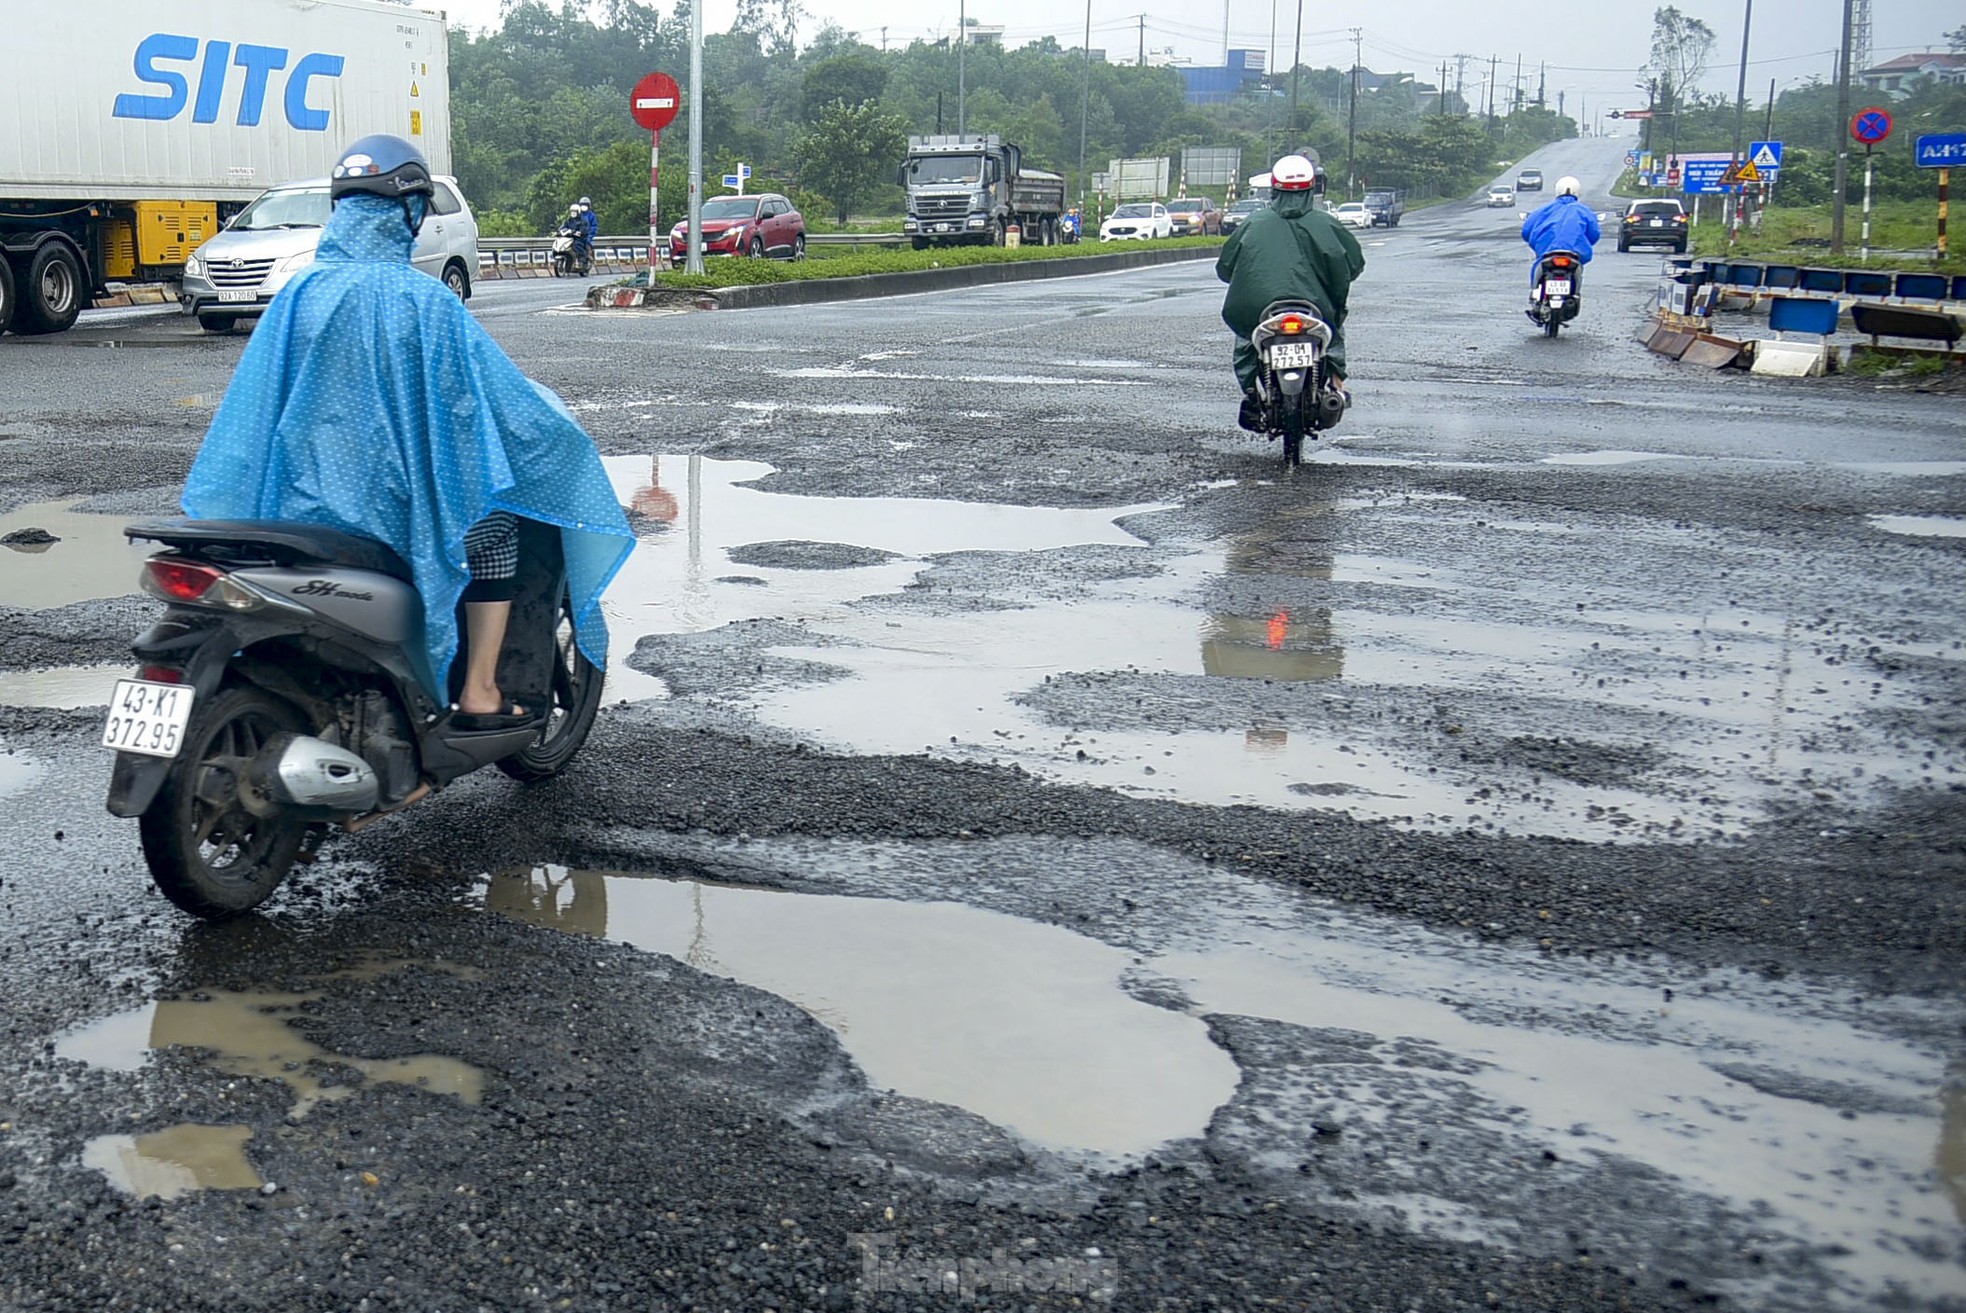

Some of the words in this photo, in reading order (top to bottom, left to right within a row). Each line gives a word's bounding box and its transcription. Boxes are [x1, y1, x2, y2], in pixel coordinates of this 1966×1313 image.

[112, 33, 346, 131] SITC
[291, 580, 342, 596] SH
[107, 716, 179, 752] 372.95
